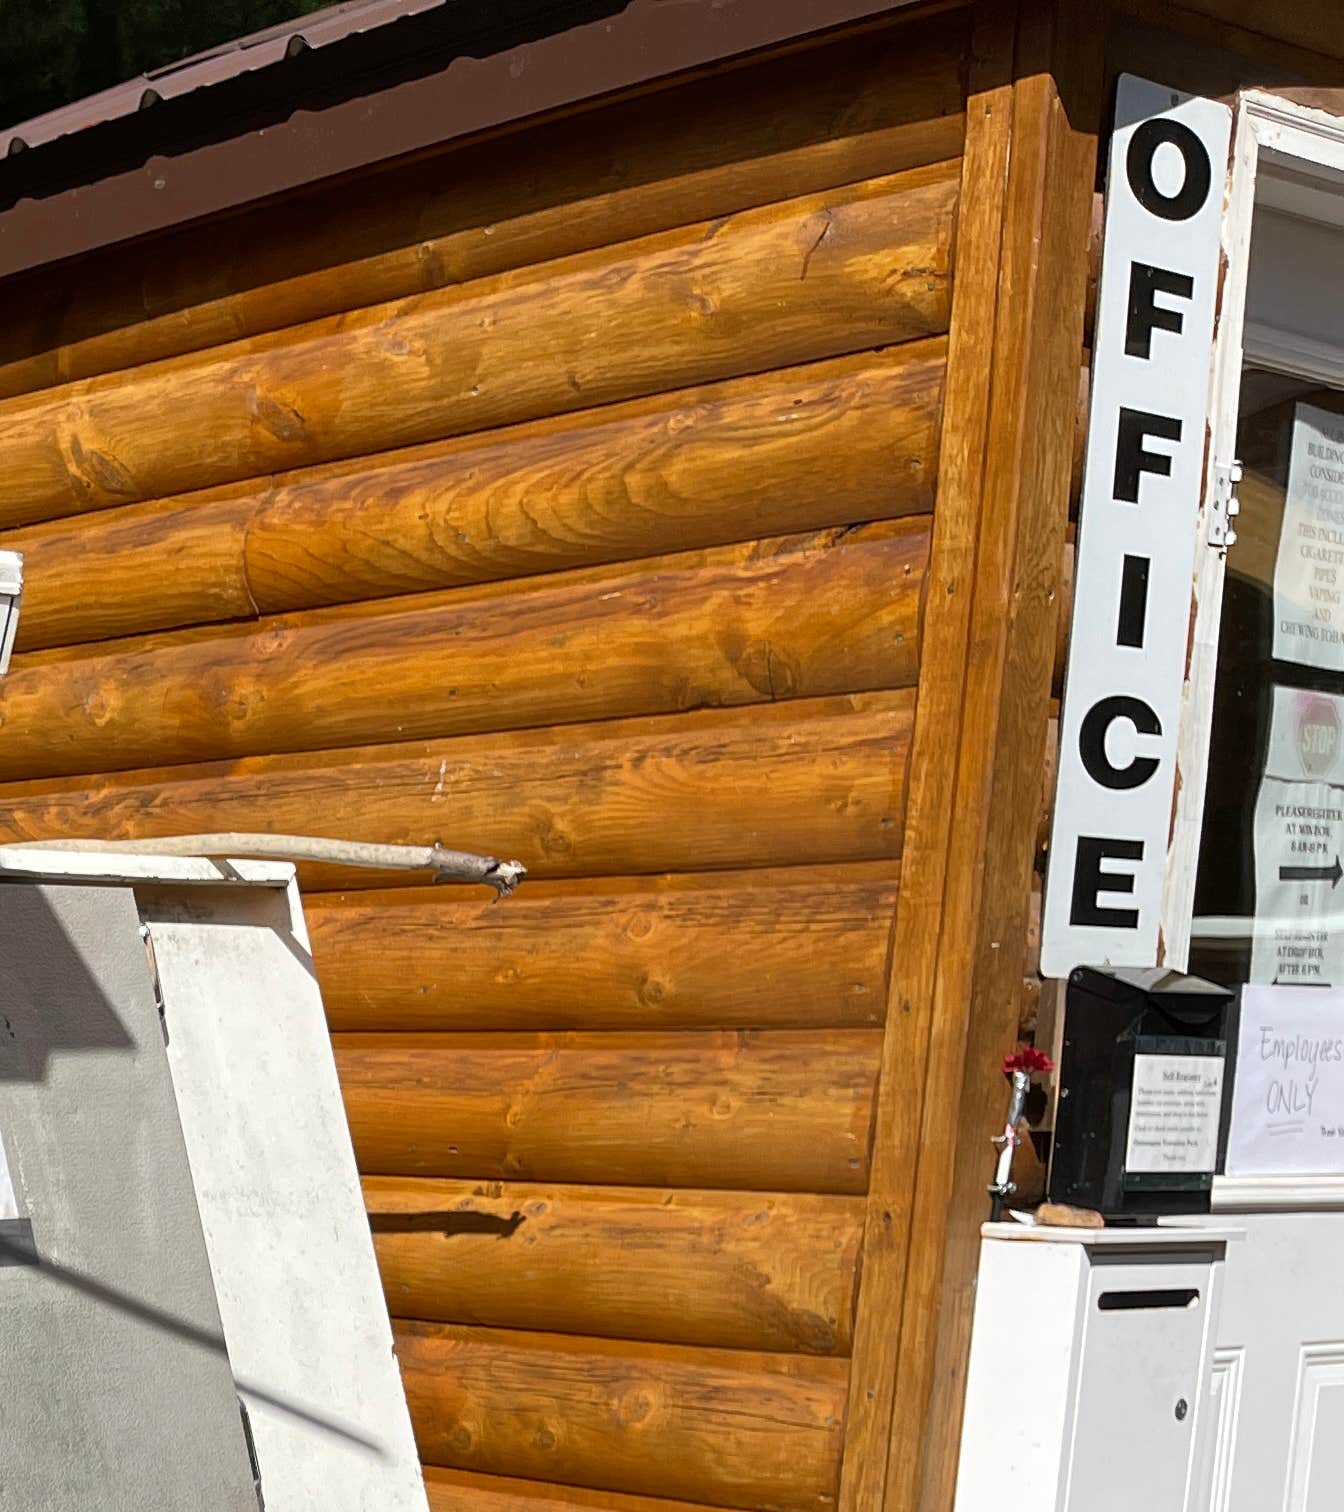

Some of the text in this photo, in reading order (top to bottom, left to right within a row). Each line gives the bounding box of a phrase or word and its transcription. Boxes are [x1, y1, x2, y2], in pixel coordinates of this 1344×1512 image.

[1067, 116, 1212, 930] OFFICE
[1302, 722, 1337, 755] STOP
[1259, 1025, 1343, 1081] Employees
[1266, 1078, 1318, 1116] ONLY
